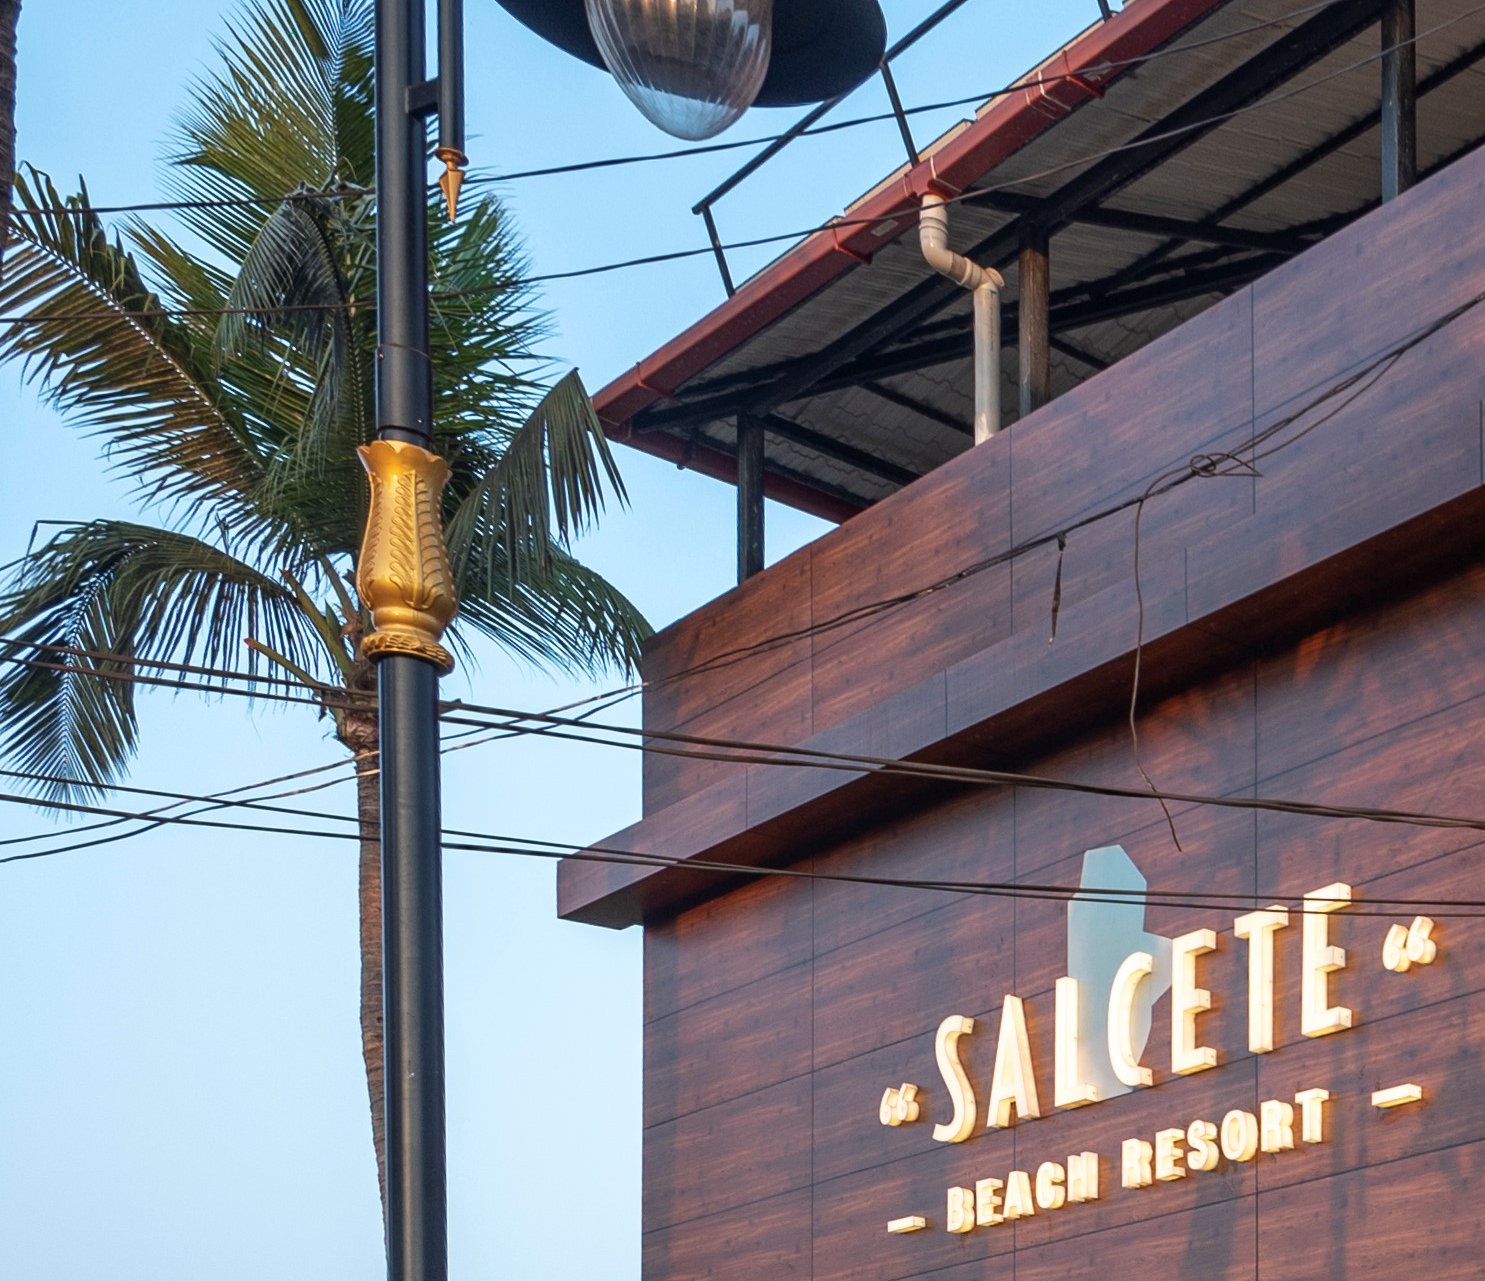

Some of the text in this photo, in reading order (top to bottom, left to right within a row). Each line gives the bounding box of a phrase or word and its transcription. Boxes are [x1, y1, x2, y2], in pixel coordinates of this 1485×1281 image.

[932, 882, 1353, 1143] SALCETE
[946, 1087, 1330, 1234] BEACH RESORT
